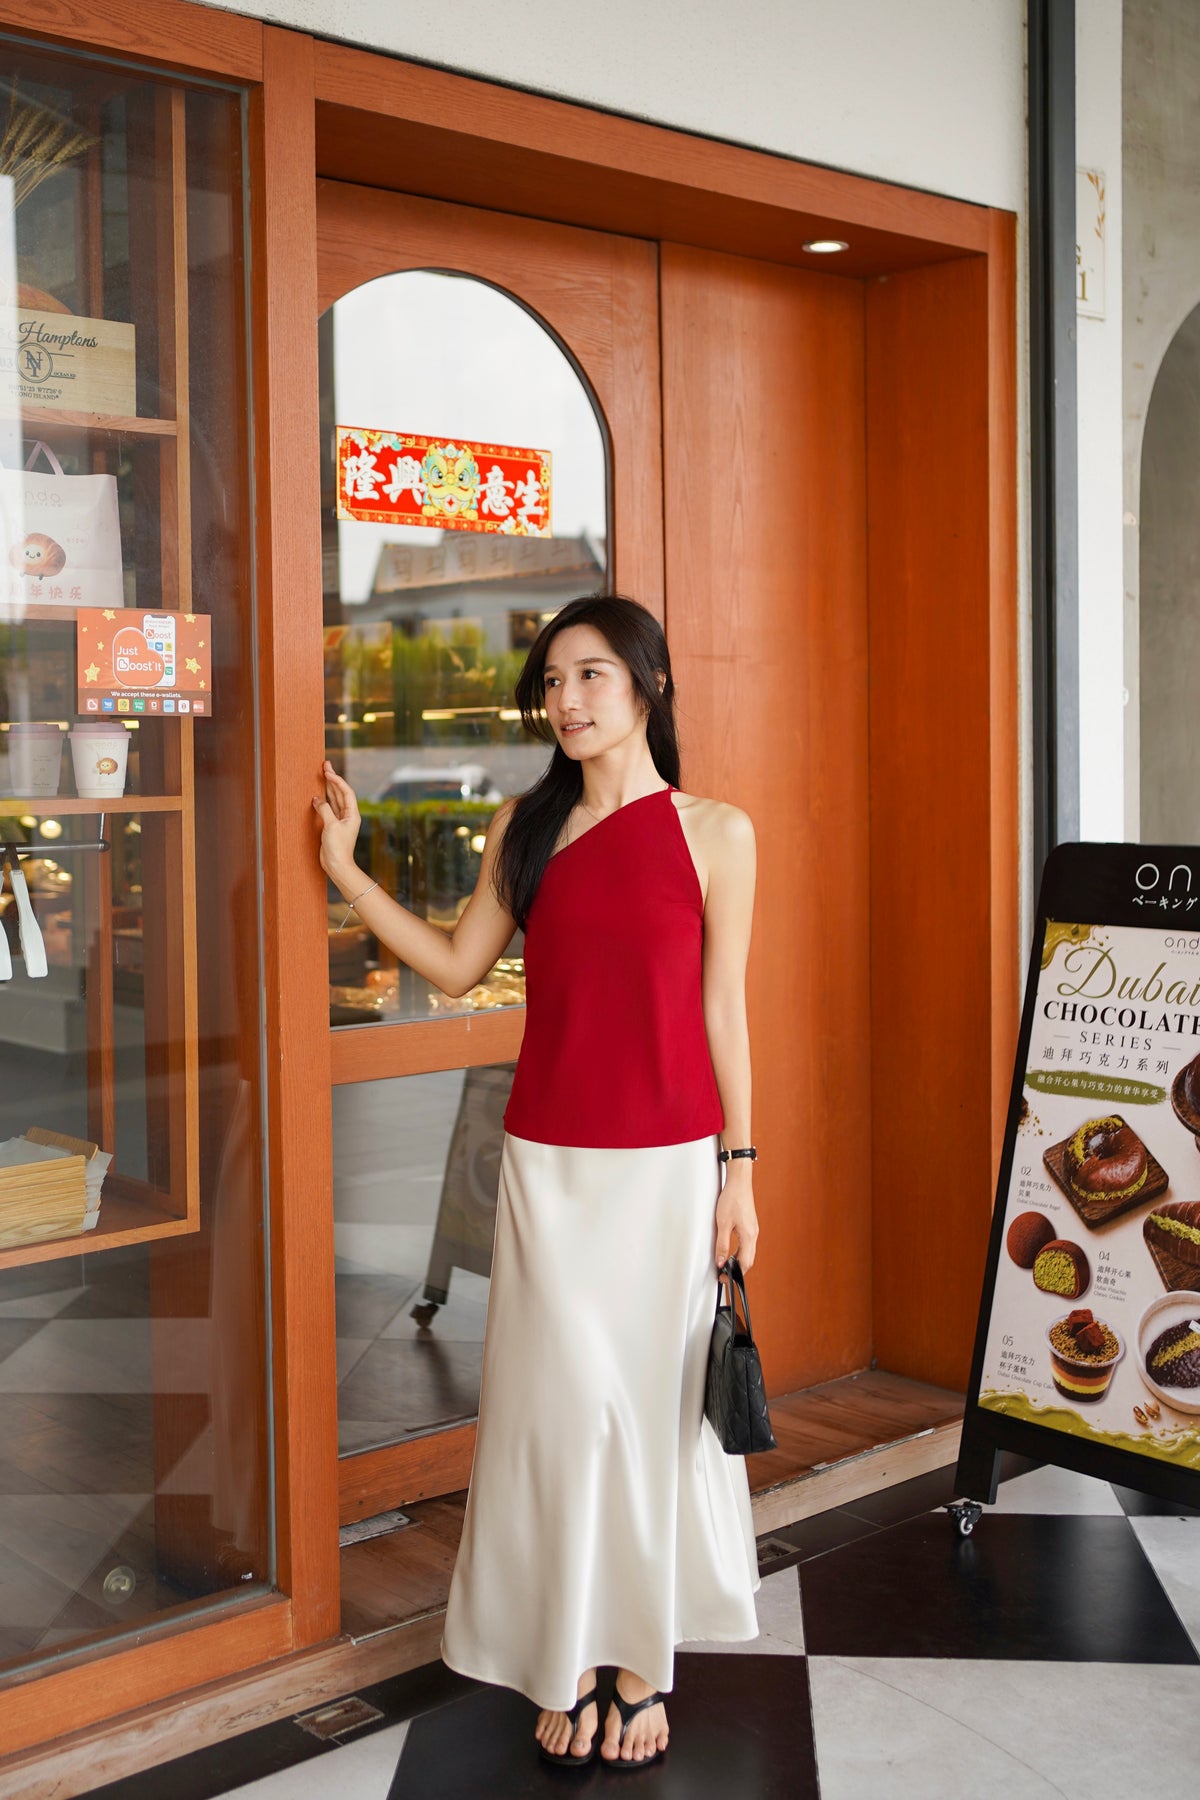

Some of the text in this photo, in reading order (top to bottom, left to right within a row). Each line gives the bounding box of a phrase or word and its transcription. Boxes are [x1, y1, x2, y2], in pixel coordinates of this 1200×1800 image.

[18, 320, 98, 350] Hamptons
[117, 646, 138, 655] Just
[1132, 895, 1198, 911] ベーキング
[1057, 946, 1200, 1006] Dubai
[1043, 1000, 1200, 1036] CHOCOLATE
[1080, 1031, 1152, 1051] SERIES
[1042, 1047, 1169, 1074] 迪拜巧克力系列
[1020, 1166, 1032, 1176] 02
[1019, 1180, 1052, 1192] 迪拜巧克力
[1098, 1250, 1110, 1261] 04
[1097, 1265, 1131, 1278] 迪拜开心果
[1002, 1335, 1014, 1346] 05
[1001, 1350, 1035, 1366] 迪拜巧克力
